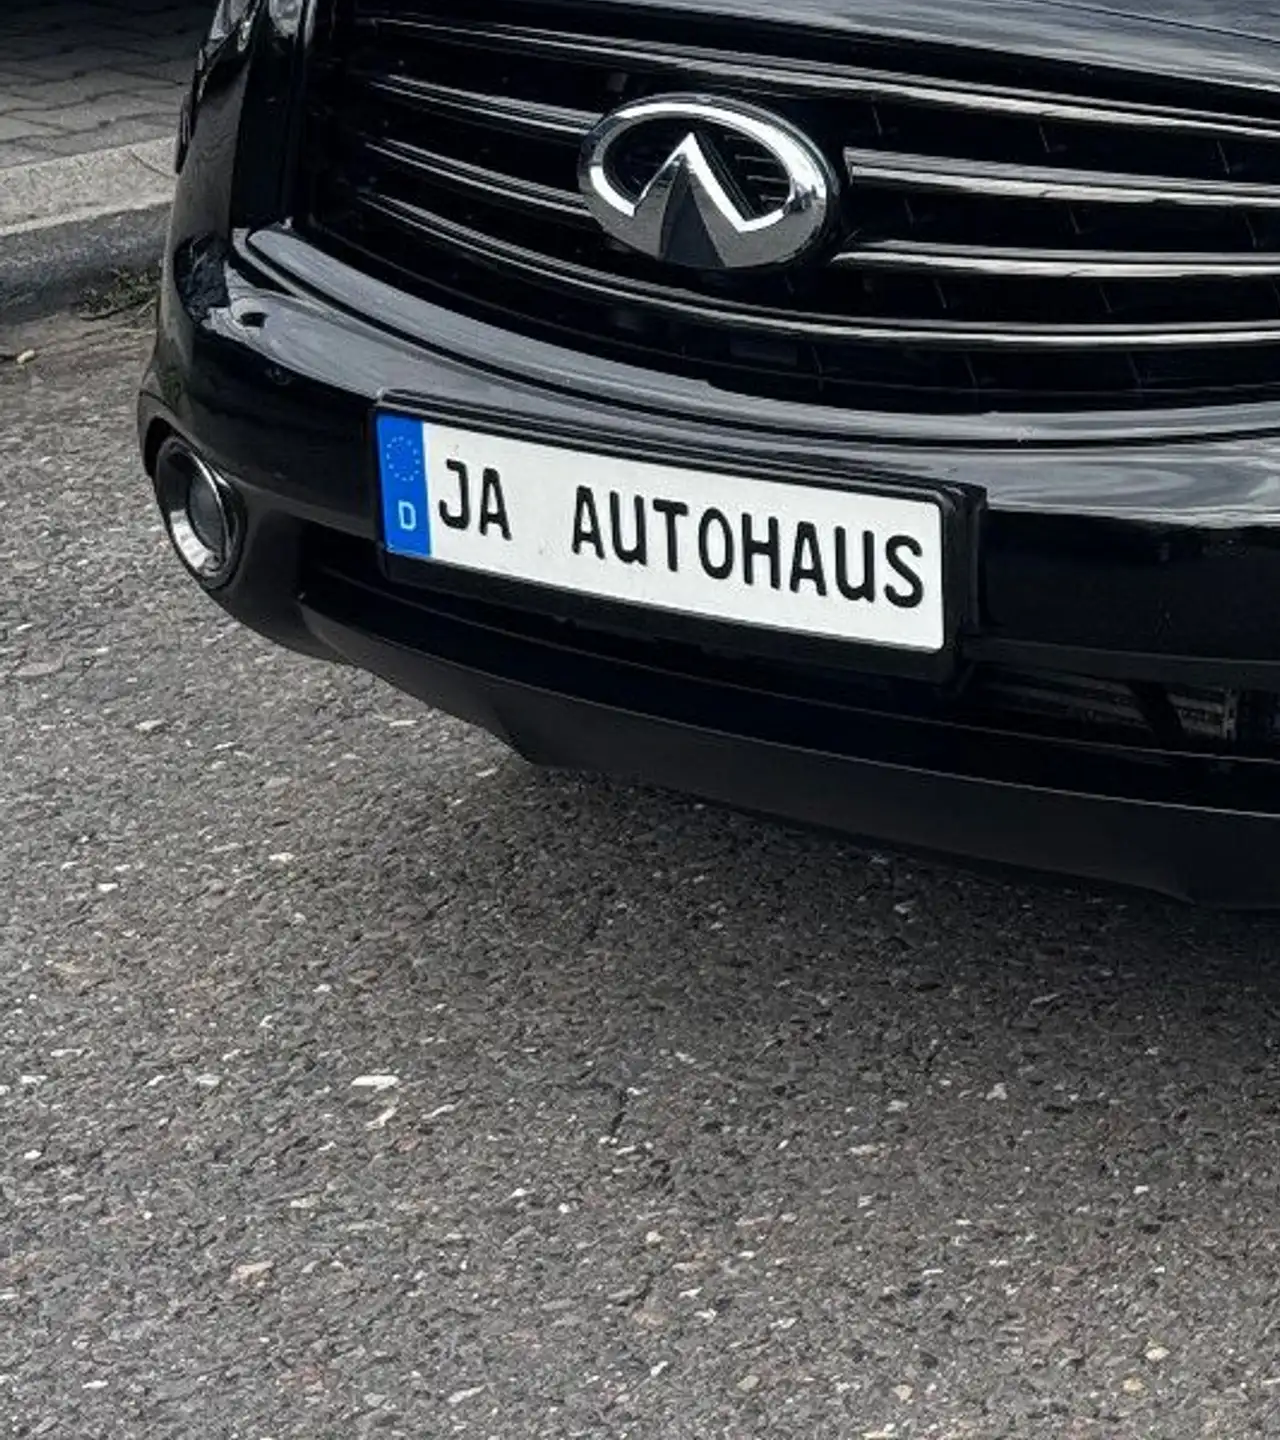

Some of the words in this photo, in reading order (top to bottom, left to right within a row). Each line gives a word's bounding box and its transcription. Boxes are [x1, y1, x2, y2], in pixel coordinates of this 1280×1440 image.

[397, 499, 417, 530] D
[438, 457, 513, 542] JA
[571, 484, 925, 609] AUTOHAUS
